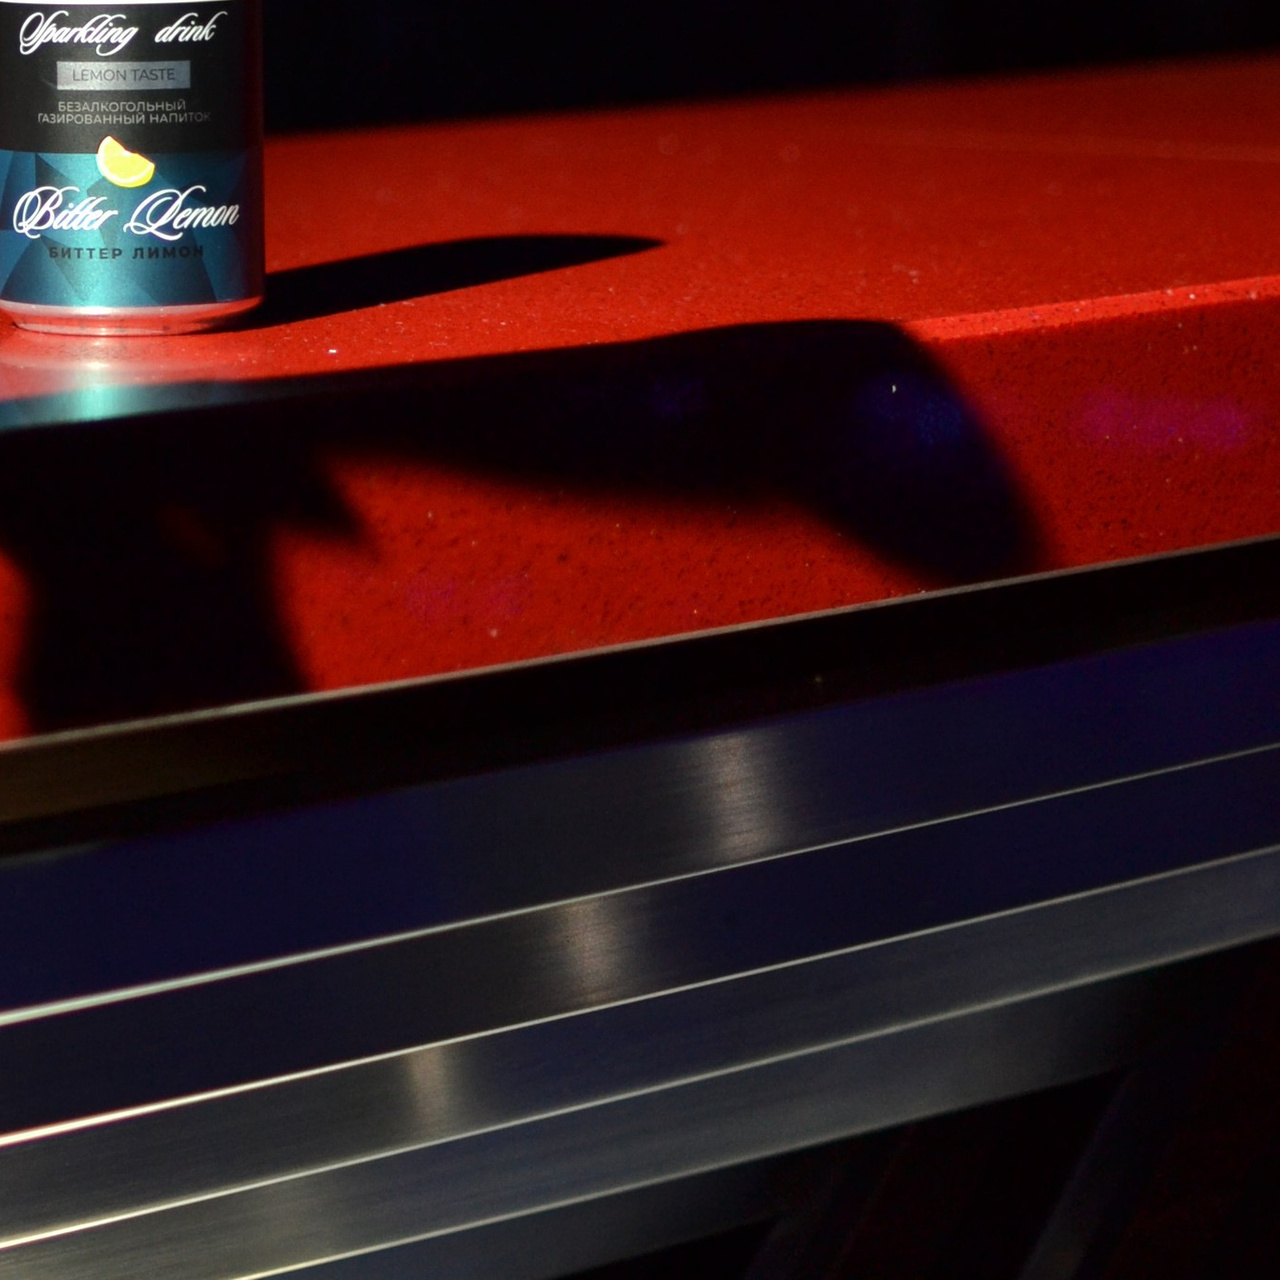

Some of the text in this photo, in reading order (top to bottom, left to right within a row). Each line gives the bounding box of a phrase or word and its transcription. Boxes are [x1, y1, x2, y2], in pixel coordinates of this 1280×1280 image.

[19, 10, 228, 57] Sparkling drink
[72, 67, 176, 82] LEMON TASTE
[58, 99, 186, 112] БЕЗАЛКОГОЛЬНЫЙ
[38, 111, 212, 125] ГАЗИРОВАННЫЙ НАПИТОК
[13, 185, 240, 241] Bitter Lemon
[49, 245, 205, 260] БИТТЕР ЛИМОН
